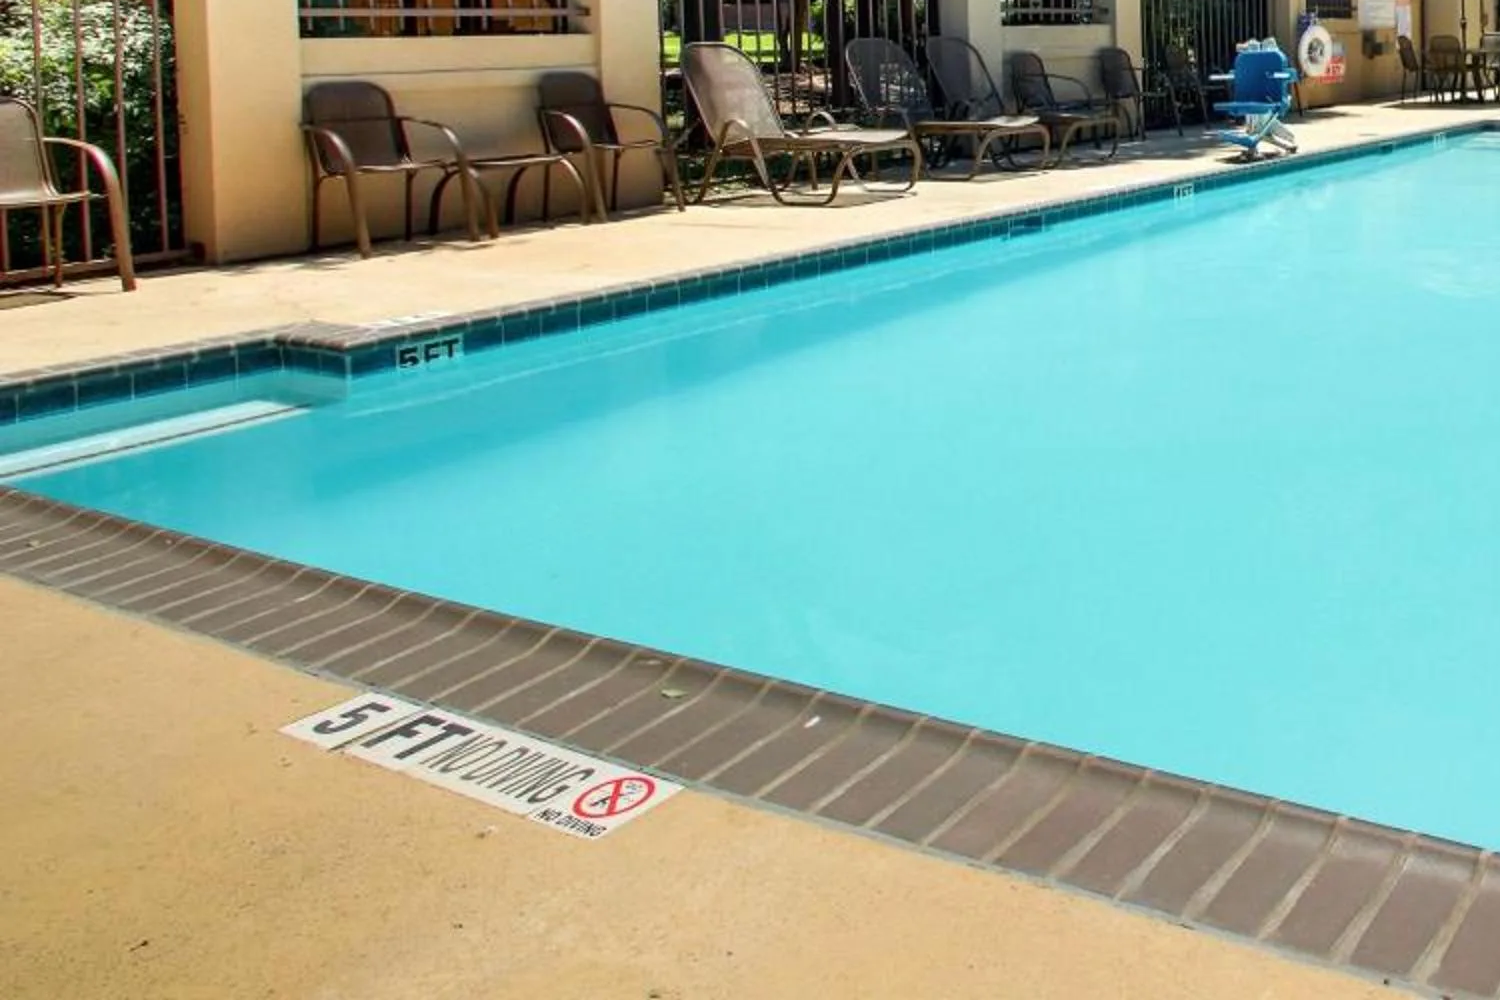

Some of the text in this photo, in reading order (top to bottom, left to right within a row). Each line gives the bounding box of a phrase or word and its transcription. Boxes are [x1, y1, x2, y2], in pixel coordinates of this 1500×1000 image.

[399, 338, 460, 367] 5 FT
[313, 701, 475, 759] 5 FT
[534, 808, 608, 837] NO DIVING
